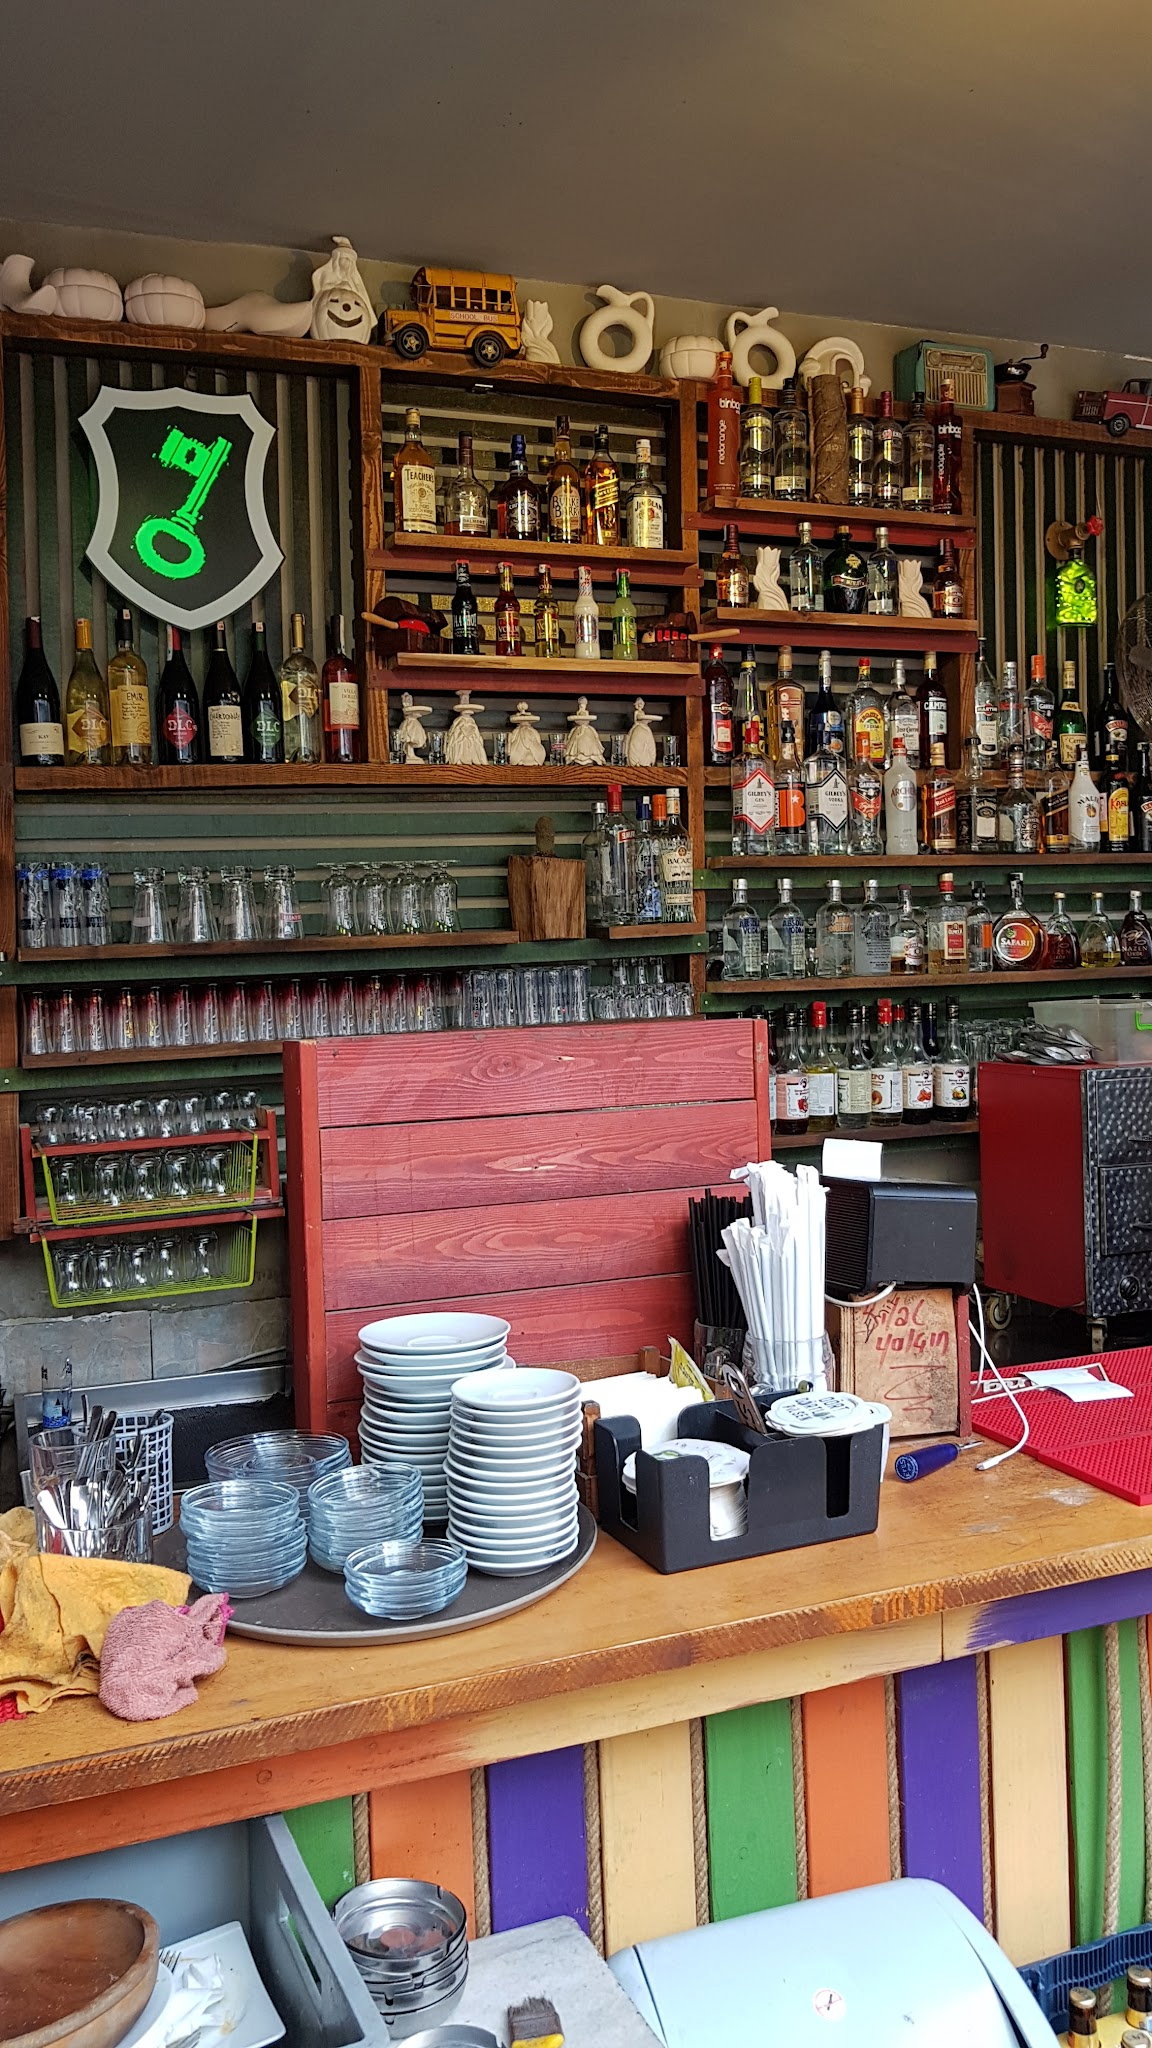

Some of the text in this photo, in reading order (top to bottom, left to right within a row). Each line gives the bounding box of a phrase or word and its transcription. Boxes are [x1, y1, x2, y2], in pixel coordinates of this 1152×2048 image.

[450, 312, 477, 320] SCHOOL
[168, 720, 193, 731] DLC
[256, 720, 280, 732] DLC
[1000, 937, 1030, 947] SAFARI
